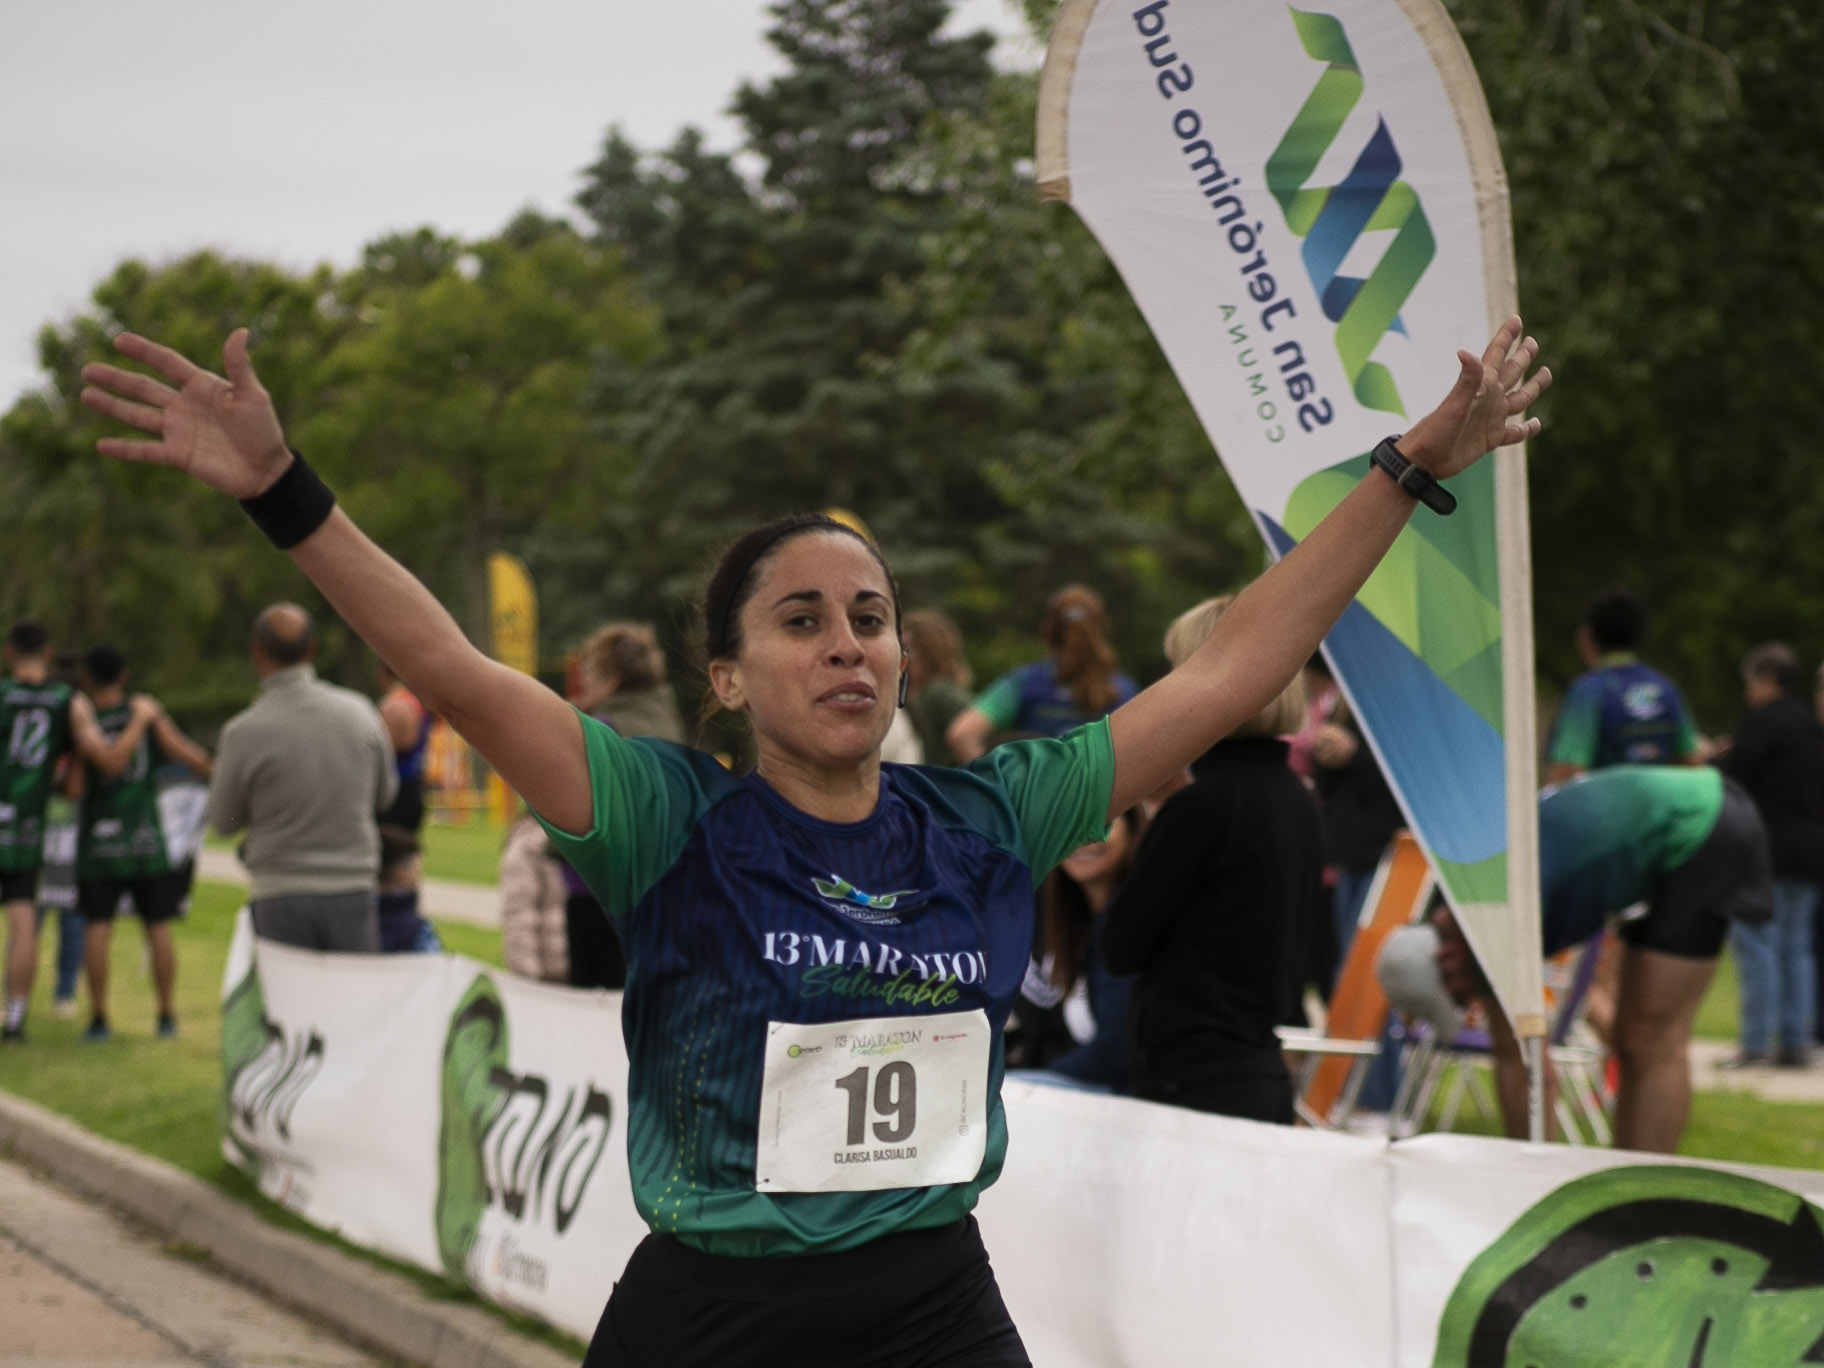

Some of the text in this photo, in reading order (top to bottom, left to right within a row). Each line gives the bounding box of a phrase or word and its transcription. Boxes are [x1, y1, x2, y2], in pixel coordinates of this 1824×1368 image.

[801, 963, 961, 1007] Saludable
[835, 1061, 917, 1146] 19
[834, 1147, 918, 1164] CLARISA BASUALDO
